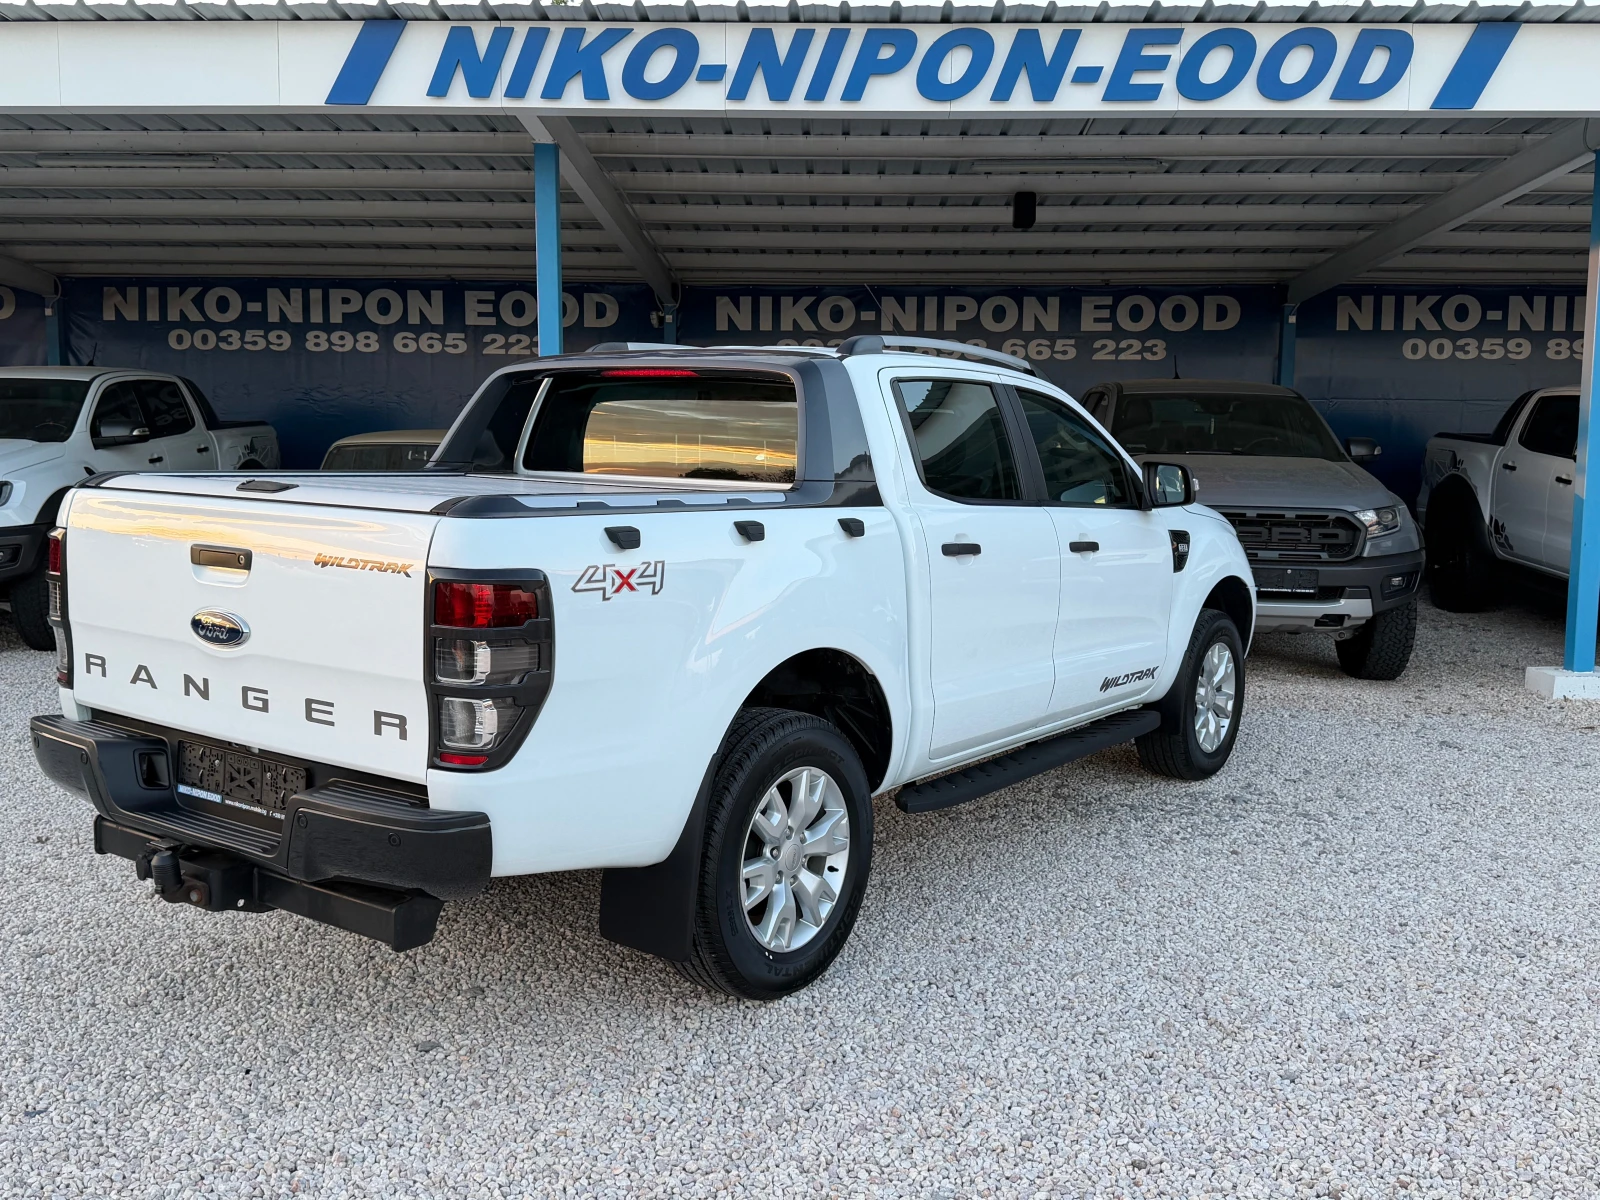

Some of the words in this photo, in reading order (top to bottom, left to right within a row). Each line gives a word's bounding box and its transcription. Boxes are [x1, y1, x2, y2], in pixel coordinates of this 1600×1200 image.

[426, 26, 1415, 102] NIKO-NIPON-EOOD
[102, 286, 444, 325] NIKO-NIPON
[715, 294, 1060, 332] NIKO-NIPON
[1081, 295, 1242, 332] EOOD
[168, 328, 292, 351] 00359
[305, 330, 380, 353] 898
[393, 331, 468, 354] 665
[482, 333, 539, 355] 22
[1002, 339, 1077, 361] 665
[1092, 339, 1168, 361] 223
[1402, 337, 1532, 360] 00359
[313, 552, 415, 579] WILDTRAK
[198, 615, 229, 640] Ford
[1099, 665, 1160, 693] WILDTRAK
[85, 652, 408, 741] RANGER
